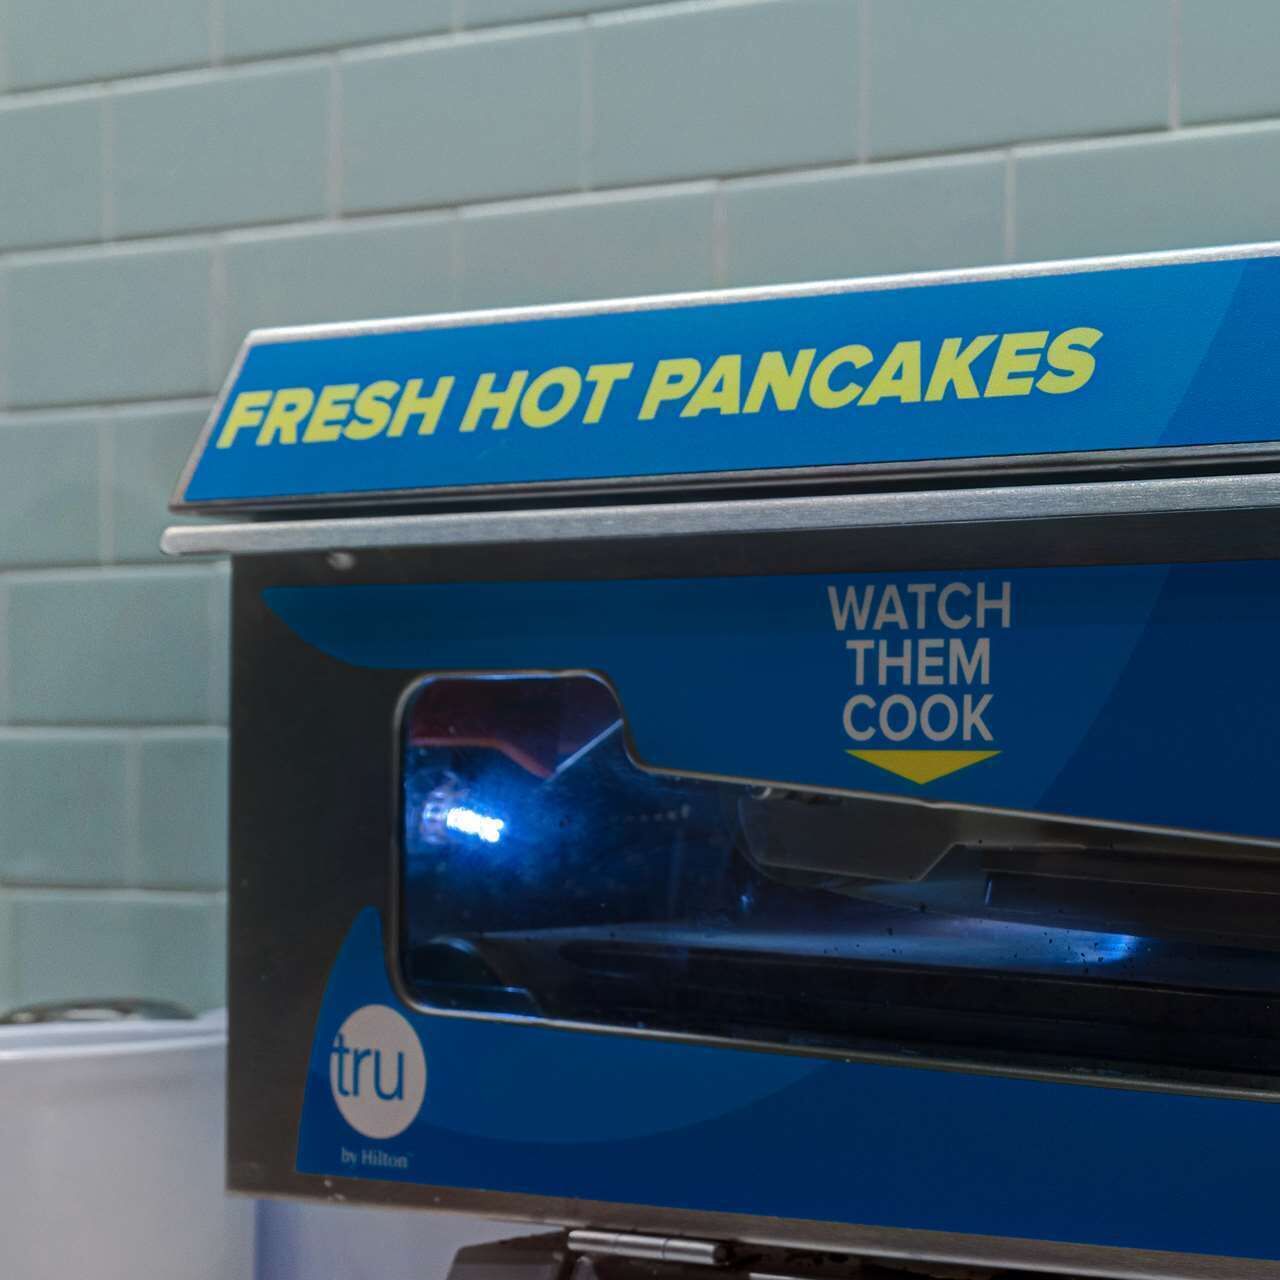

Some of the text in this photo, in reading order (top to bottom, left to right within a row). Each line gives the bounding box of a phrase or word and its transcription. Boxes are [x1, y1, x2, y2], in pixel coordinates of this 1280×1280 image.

[217, 327, 1104, 449] FRESH HOT PANCAKES
[827, 581, 1011, 631] WATCH
[846, 637, 990, 686] THEM
[843, 693, 994, 741] COOK
[332, 1033, 404, 1101] tru
[341, 1148, 408, 1168] by Hilton
